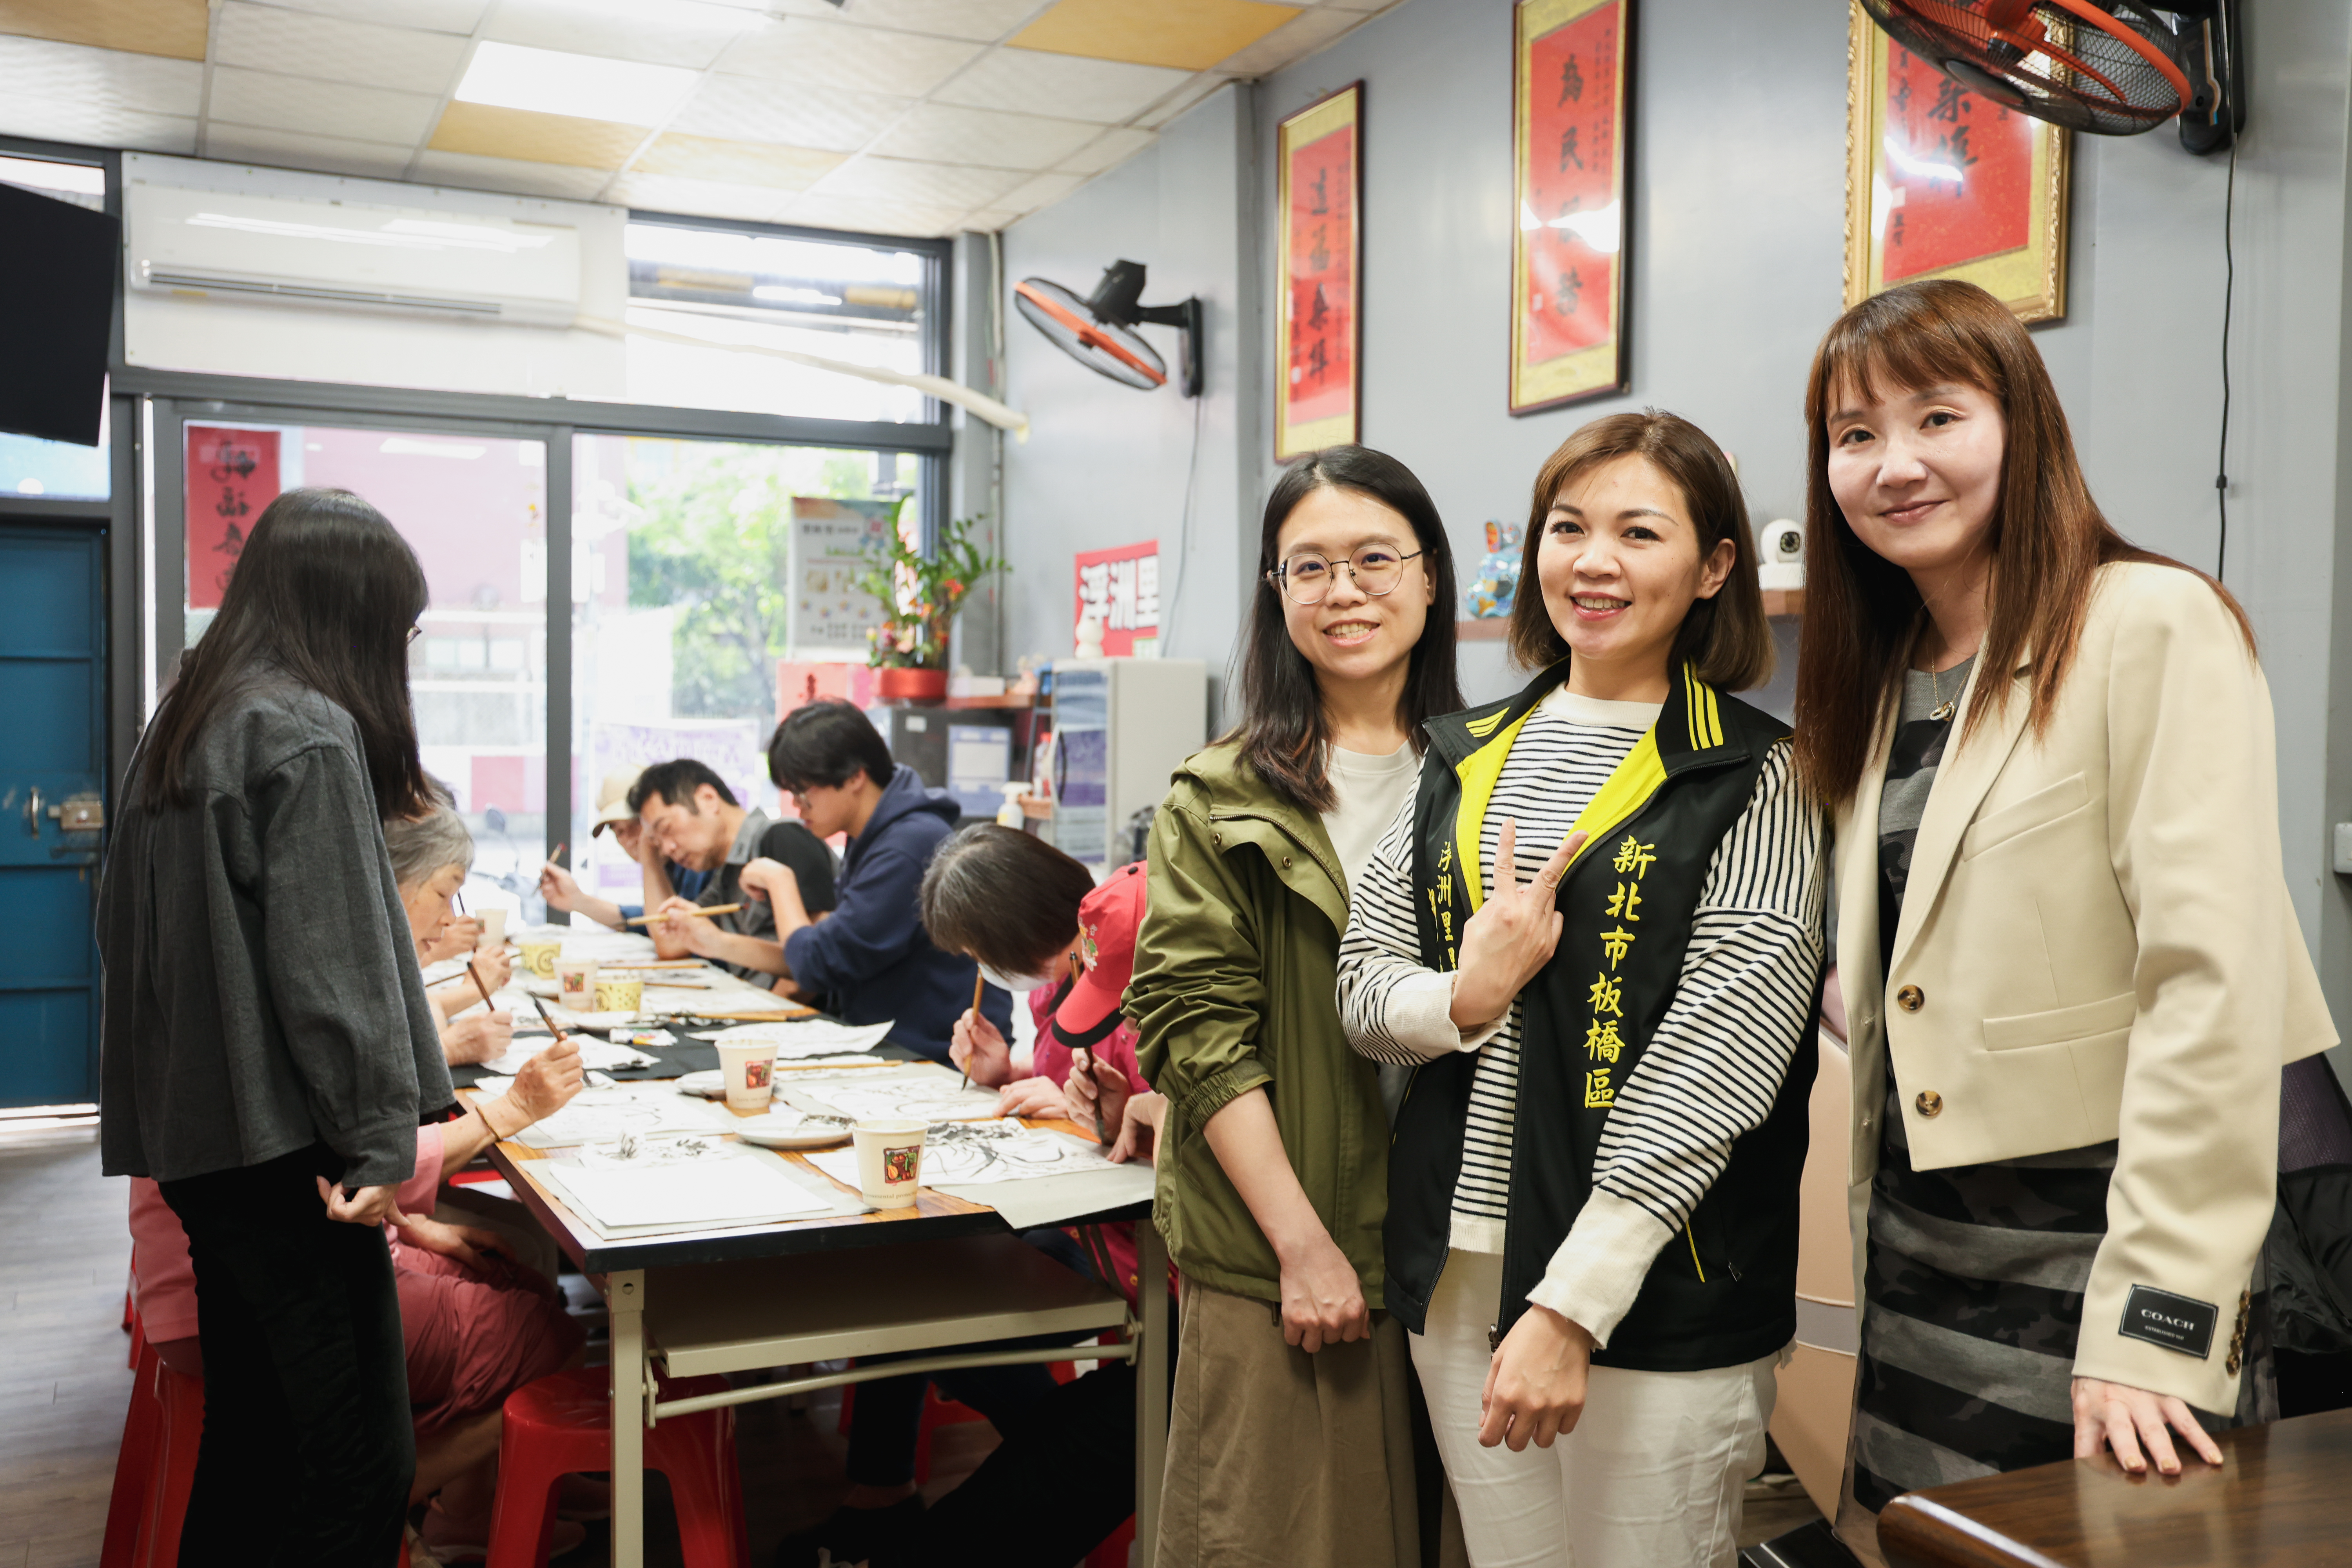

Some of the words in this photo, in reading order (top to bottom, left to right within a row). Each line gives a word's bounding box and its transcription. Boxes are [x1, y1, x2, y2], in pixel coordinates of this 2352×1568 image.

[1078, 555, 1159, 630] 浮洲里
[1583, 835, 1657, 1109] 新北市板橋區
[2141, 1308, 2195, 1331] COACH
